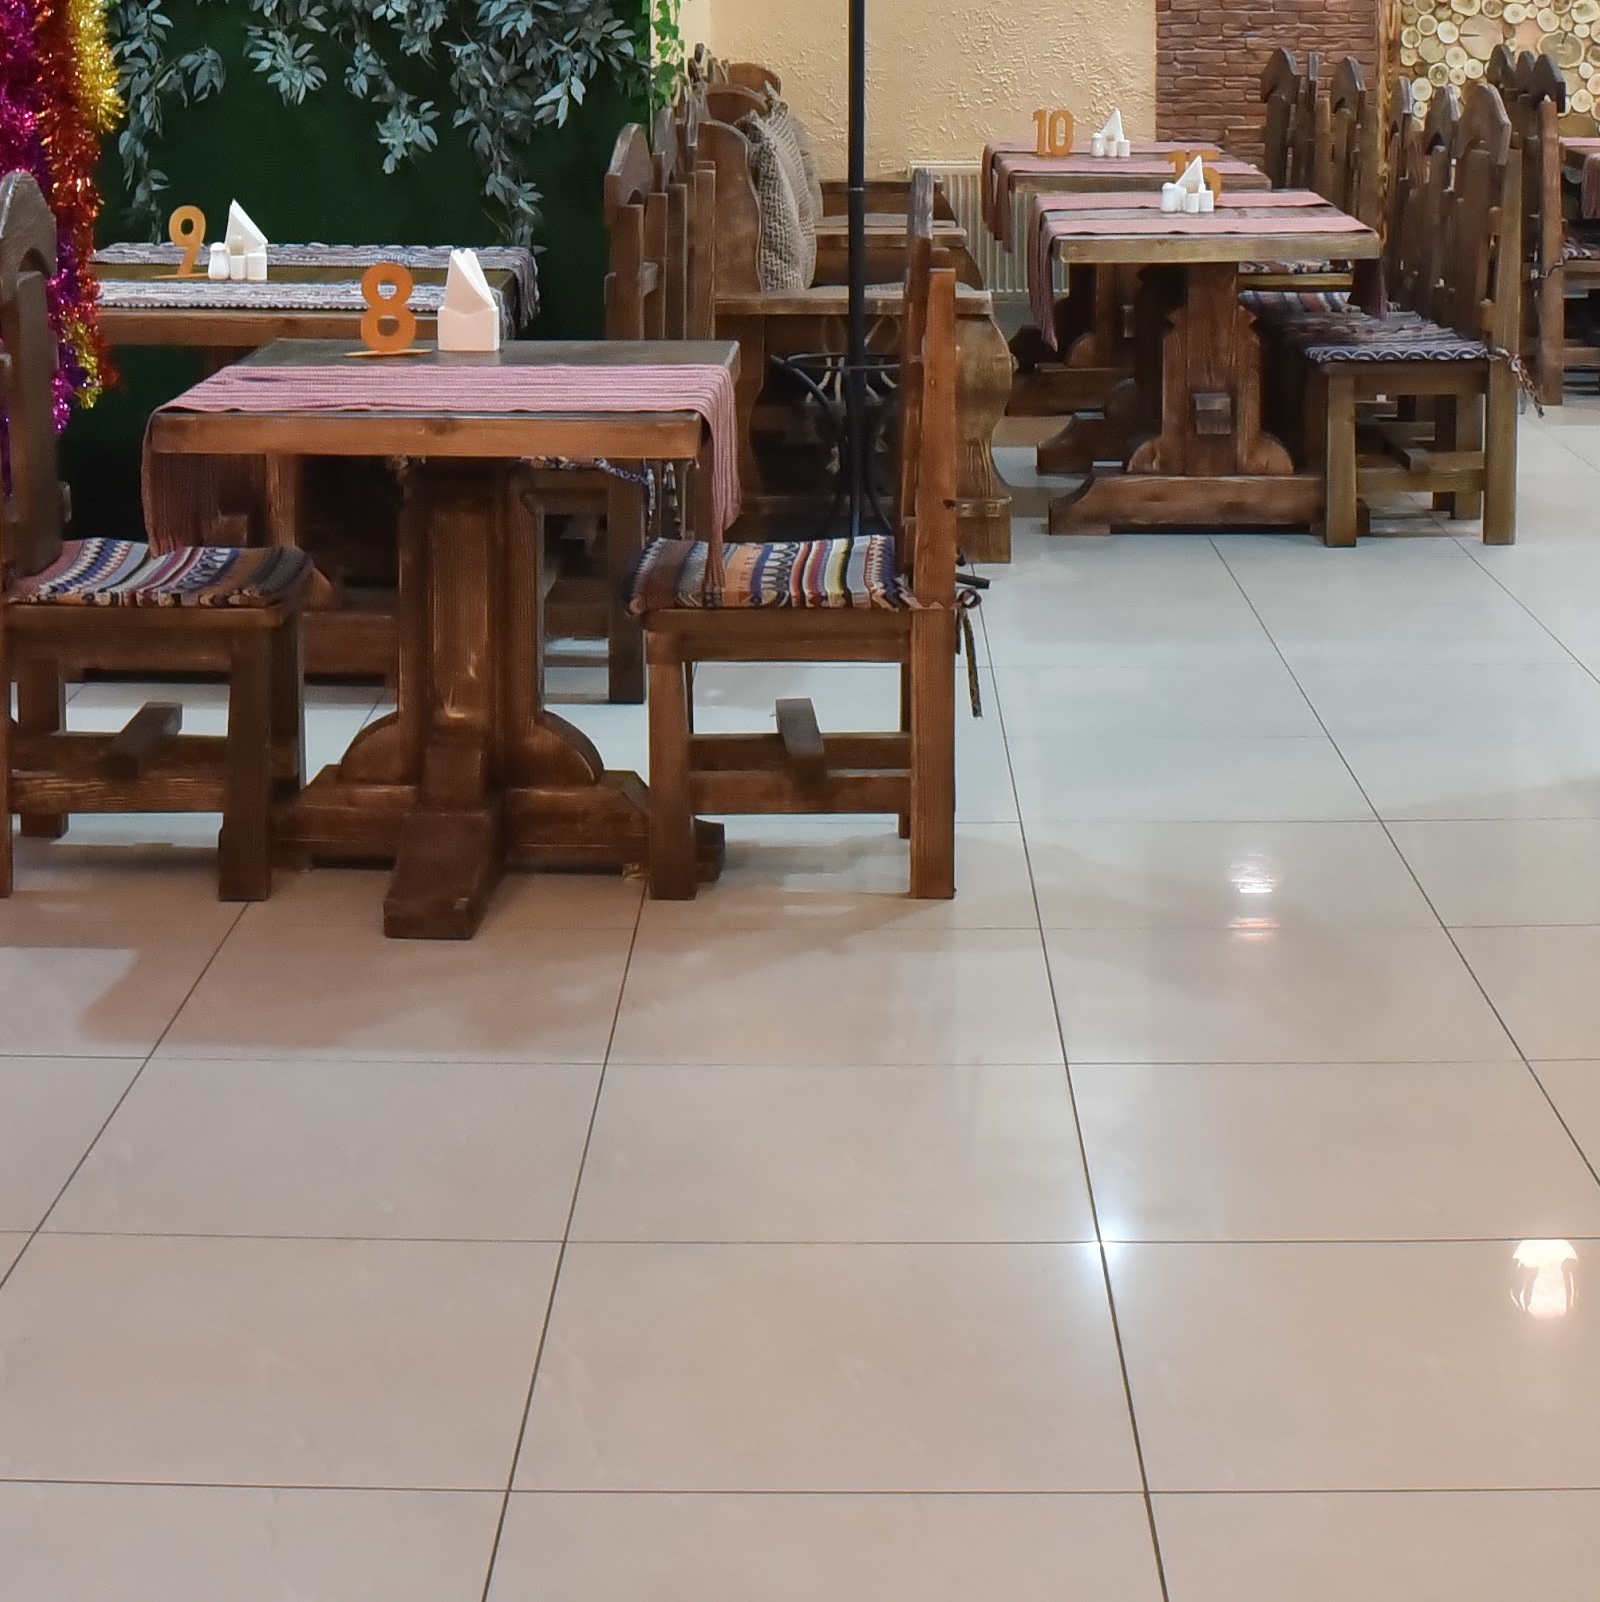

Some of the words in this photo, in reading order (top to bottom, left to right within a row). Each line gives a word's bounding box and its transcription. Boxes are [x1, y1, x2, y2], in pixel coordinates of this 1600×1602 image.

[1032, 109, 1073, 155] 10
[168, 205, 206, 275] 9
[360, 262, 417, 352] 8
